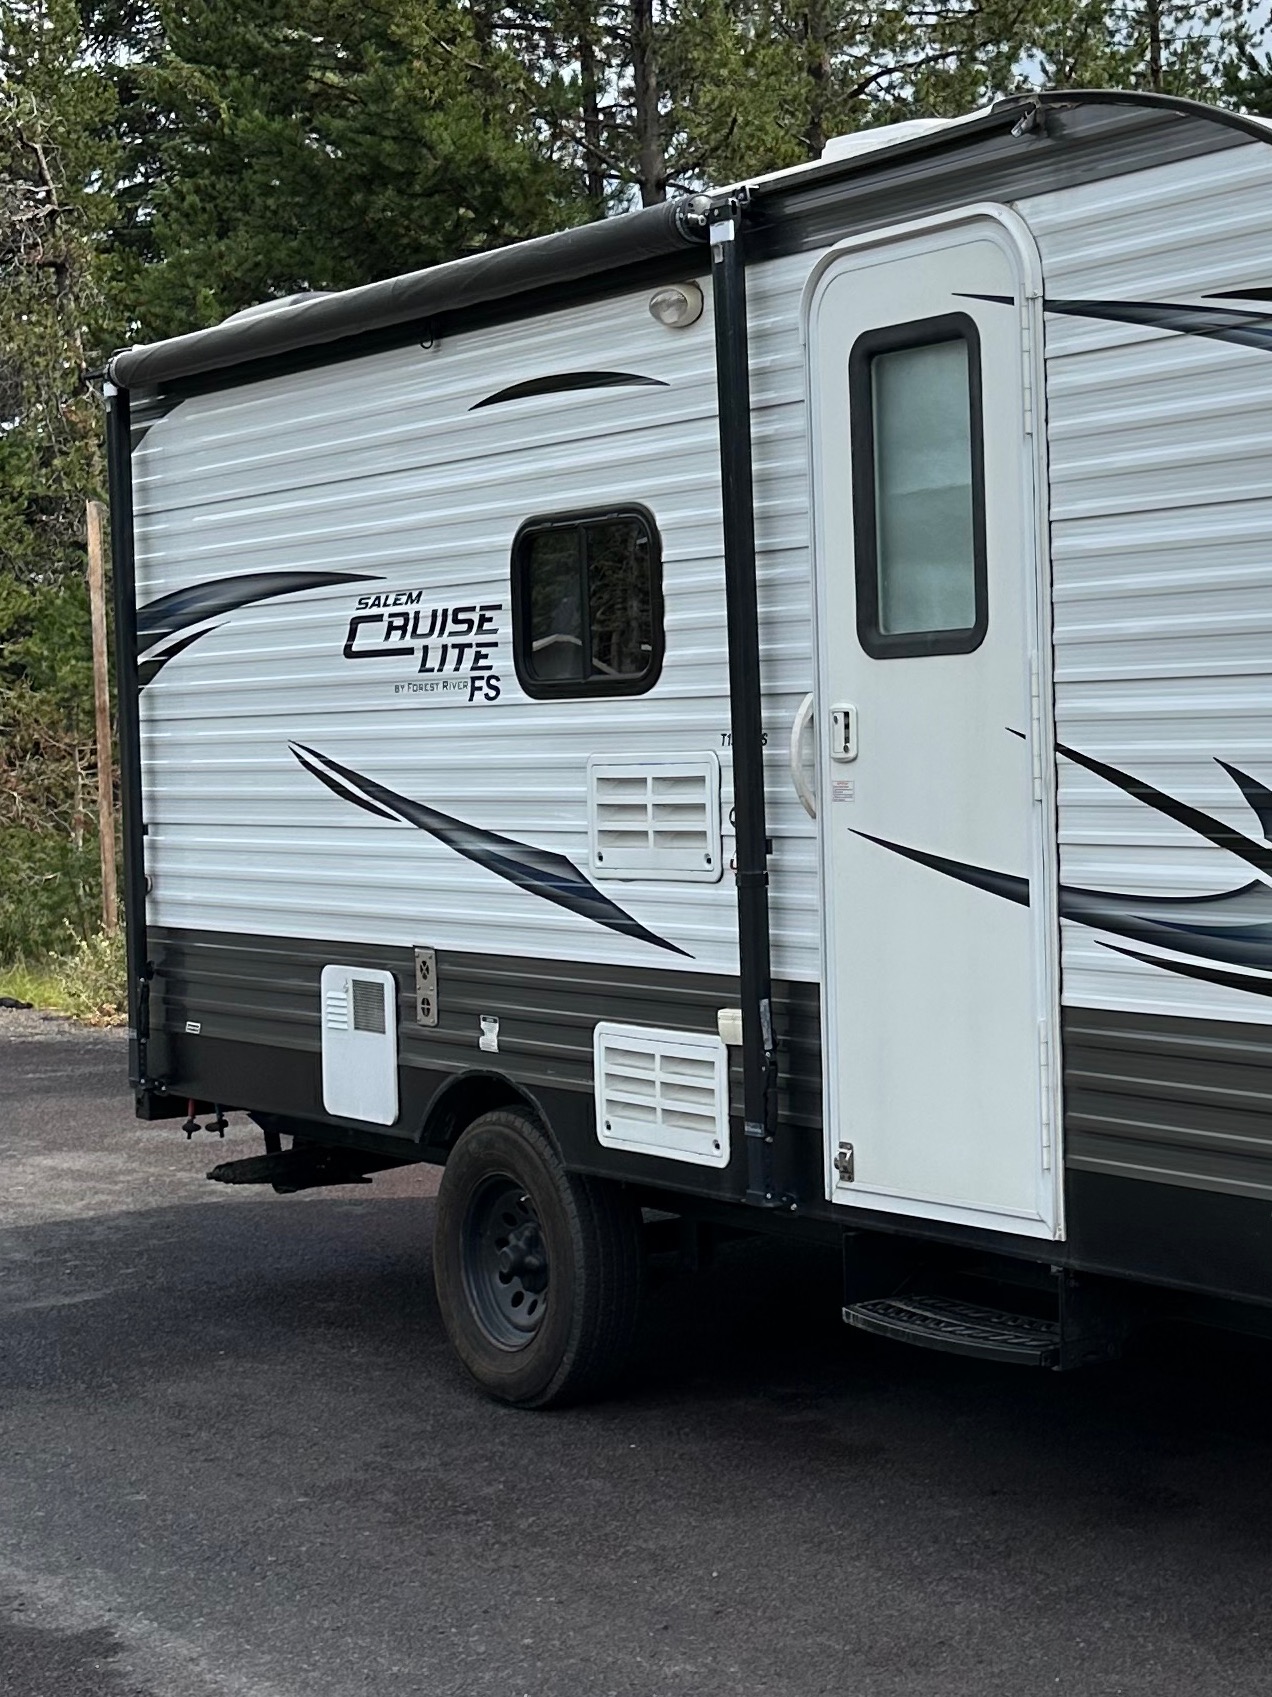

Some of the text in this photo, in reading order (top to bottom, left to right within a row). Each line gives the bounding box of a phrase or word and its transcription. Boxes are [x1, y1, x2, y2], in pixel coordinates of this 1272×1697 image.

[355, 590, 423, 611] SALEM
[343, 603, 503, 659] CRUISE
[417, 641, 499, 674] LITE
[468, 674, 501, 702] FS
